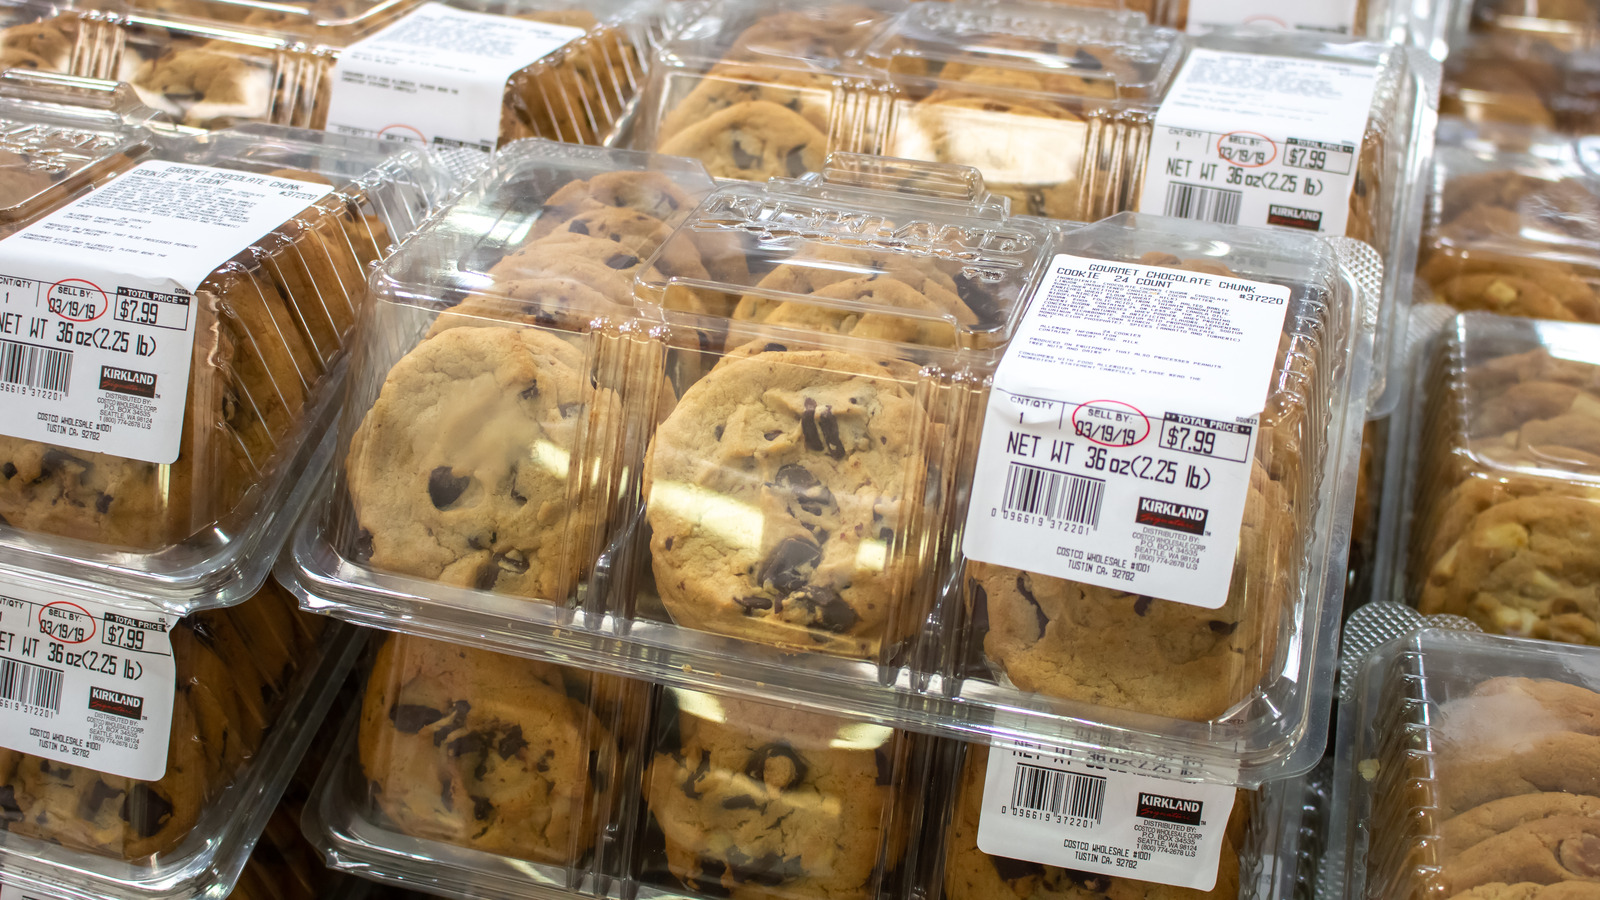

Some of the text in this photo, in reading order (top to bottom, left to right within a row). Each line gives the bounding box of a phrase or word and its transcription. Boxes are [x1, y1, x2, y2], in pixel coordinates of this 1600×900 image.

[1176, 140, 1180, 151] 1
[1219, 146, 1265, 165] 03/19/19
[1289, 148, 1326, 169] $7.99
[132, 169, 172, 178] COOKIE
[196, 177, 228, 186] COUNT
[166, 166, 303, 191] GOURMET CHOCOLATE CHUNK
[1166, 157, 1192, 177] NET
[1200, 162, 1218, 181] WT
[1226, 166, 1243, 185] 36
[1304, 178, 1323, 196] lb)
[279, 191, 318, 201] #37220
[1271, 206, 1319, 221] KIRKLAND
[1057, 267, 1101, 279] COOKIE
[1136, 278, 1173, 288] COUNT
[1089, 264, 1256, 293] GOURMET CHOCOLATE CHUNK
[6, 292, 9, 303] 1
[58, 286, 93, 299] SELL BY:
[128, 290, 178, 304] TOTAL PRICE
[1239, 294, 1284, 305] #37220
[48, 298, 96, 319] 03/19/19
[120, 299, 158, 324] $7.99
[30, 317, 48, 340] WT
[56, 321, 74, 343] 36
[136, 334, 156, 356] lb)
[103, 368, 155, 385] KIRKLAND
[31, 389, 62, 401] 372201
[97, 397, 116, 406] COSTCO
[117, 401, 143, 410] WHOLESALE
[106, 392, 141, 403] DISTRIBUTED
[1010, 396, 1054, 410] CNT/QTY
[37, 412, 58, 423] COSTCO
[61, 417, 93, 429] WHOLESALE
[1020, 412, 1024, 424] 1
[1088, 409, 1133, 424] SELL BY:
[1177, 416, 1238, 432] TOTAL PRICE
[47, 423, 66, 434] TUSTIN
[82, 430, 100, 440] 92782
[1075, 420, 1135, 445] 03/19/19
[1167, 426, 1216, 454] $7.99
[1007, 431, 1041, 458] NET
[1050, 439, 1075, 464] WT
[1085, 446, 1107, 470] 36
[1185, 465, 1211, 490] lb)
[1141, 499, 1205, 521] KIRKLAND
[991, 508, 1089, 535] 0 096619 372201
[1132, 532, 1206, 552] COSTCO WHOLESALE CORP.
[1143, 527, 1188, 541] DISTRIBUTED
[1135, 546, 1167, 557] SEATTLE,
[1180, 555, 1200, 564] 98124
[1157, 543, 1174, 551] BOX
[1175, 546, 1198, 557] 34535
[1056, 546, 1150, 573] COSTCO WHOLESALE #1001
[1138, 554, 1155, 563] (800)
[1156, 556, 1185, 568] 774-2678
[1068, 560, 1093, 573] TUSTIN
[1112, 569, 1135, 582] 92782
[49, 609, 82, 622] SELL BY:
[115, 616, 136, 627] TOTAL
[138, 621, 163, 631] PRICE
[40, 619, 84, 642] 03/19/19
[108, 625, 144, 649] $7.99
[22, 636, 40, 658] WT
[48, 642, 64, 663] 36
[124, 659, 143, 680] lb)
[92, 688, 141, 708] KIRKLAND
[24, 705, 53, 719] 372201
[30, 727, 50, 739] COSTCO
[52, 733, 83, 747] WHOLESALE
[39, 739, 57, 750] TUSTIN
[72, 747, 90, 758] 92782
[1141, 795, 1200, 812] KIRKLAND
[1002, 806, 1093, 828] 0 096619 372201
[1144, 820, 1185, 831] DISTRIBUTED
[1134, 824, 1156, 833] COSTCO
[1156, 828, 1187, 838] WHOLESALE
[1137, 837, 1166, 847] SEATTLE,
[1175, 836, 1196, 845] 34535
[1063, 839, 1151, 861] COSTCO WHOLESALE #1001
[1141, 844, 1156, 852] (800)
[1157, 846, 1184, 856] 774-2678
[1075, 852, 1098, 863] TUSTIN
[1116, 859, 1137, 869] 92782
